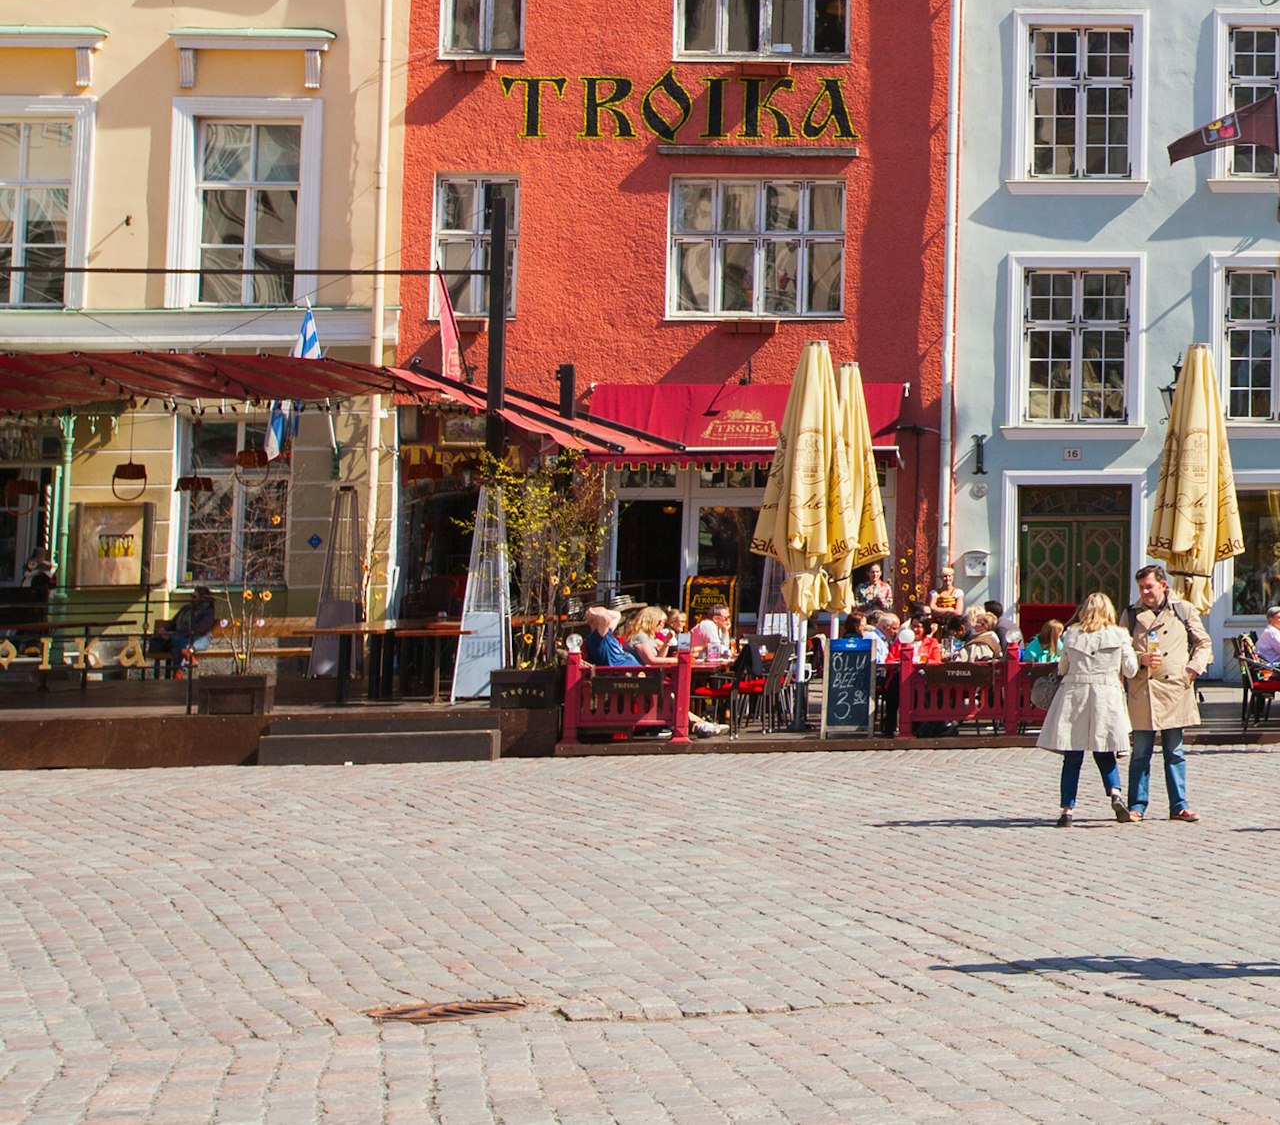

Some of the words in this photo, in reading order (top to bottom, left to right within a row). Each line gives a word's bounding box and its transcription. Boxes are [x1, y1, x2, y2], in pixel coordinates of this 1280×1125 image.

[500, 65, 860, 144] TROIKA
[715, 423, 769, 433] TROIKA
[1066, 449, 1079, 458] 16
[1218, 537, 1245, 557] saku
